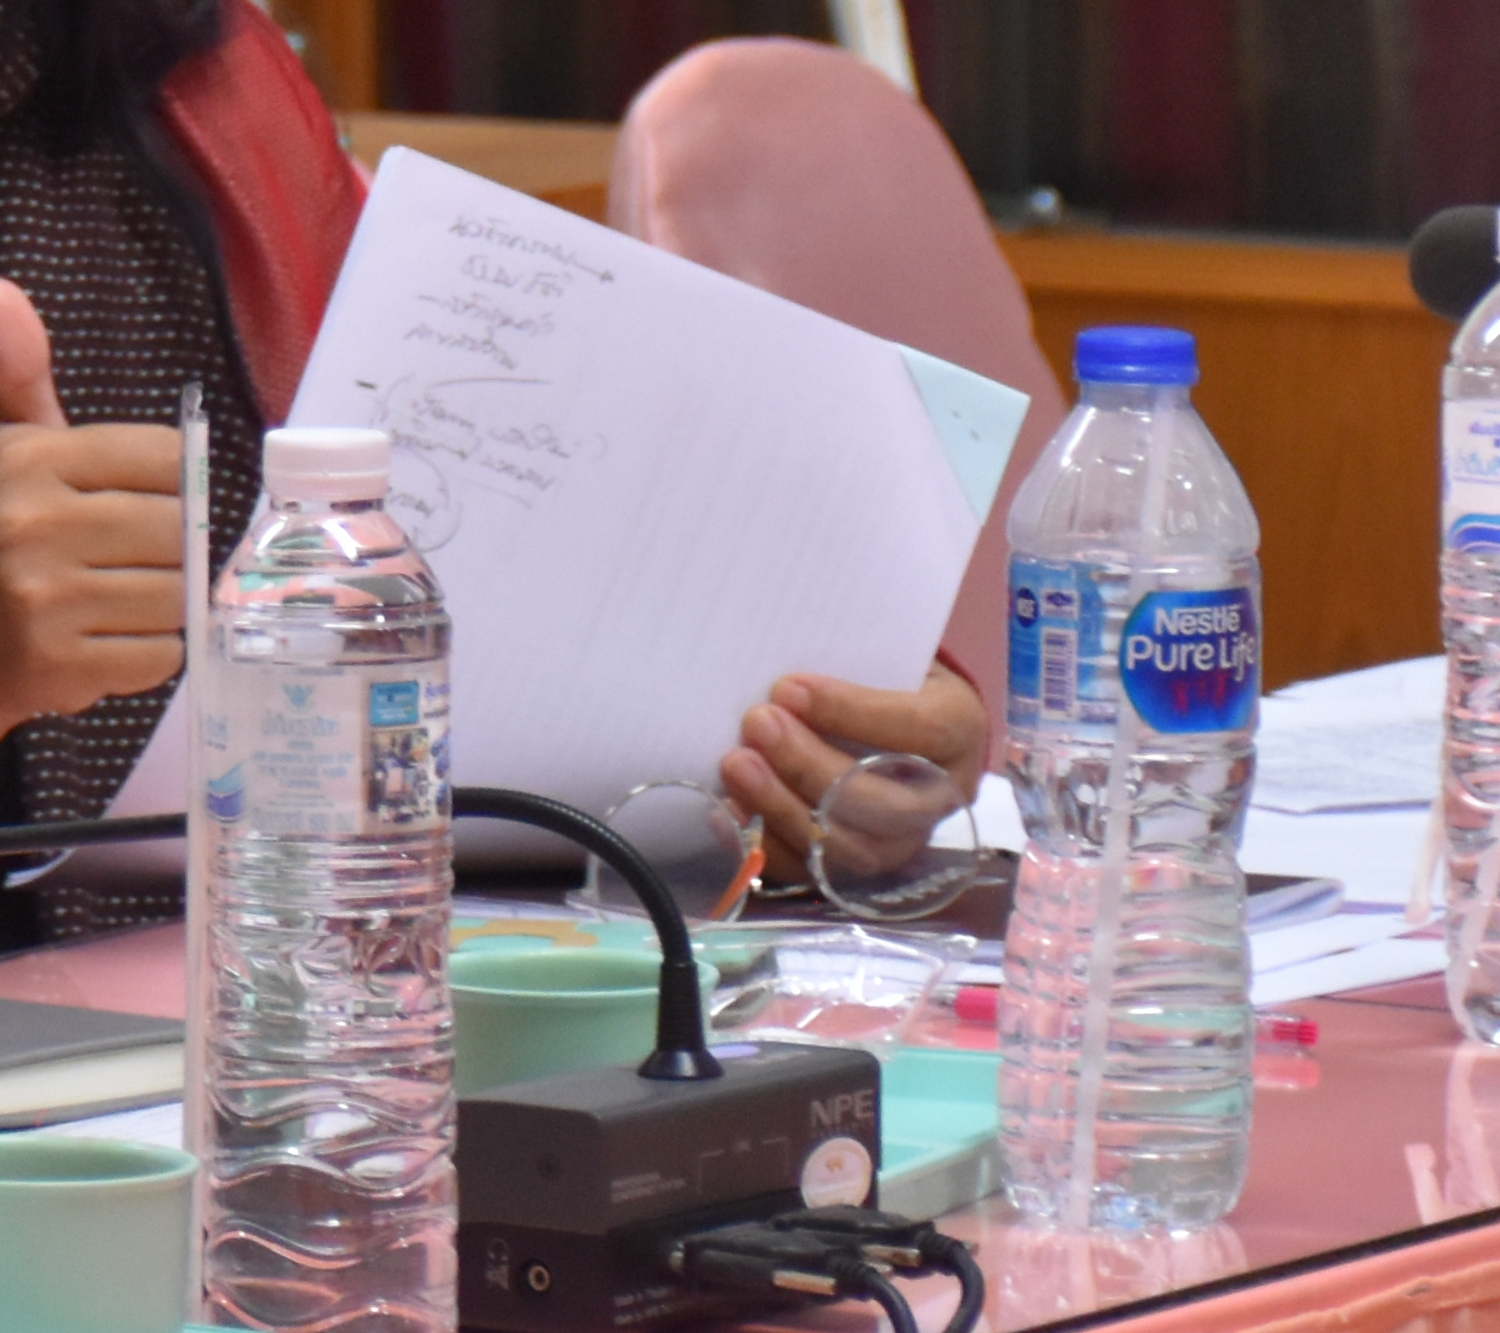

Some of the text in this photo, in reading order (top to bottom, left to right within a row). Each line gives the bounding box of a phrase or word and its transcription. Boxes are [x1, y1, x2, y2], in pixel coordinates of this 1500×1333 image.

[1155, 603, 1244, 636] Nestlé
[1127, 632, 1255, 682] Pure Life
[810, 1088, 875, 1129] NPE
